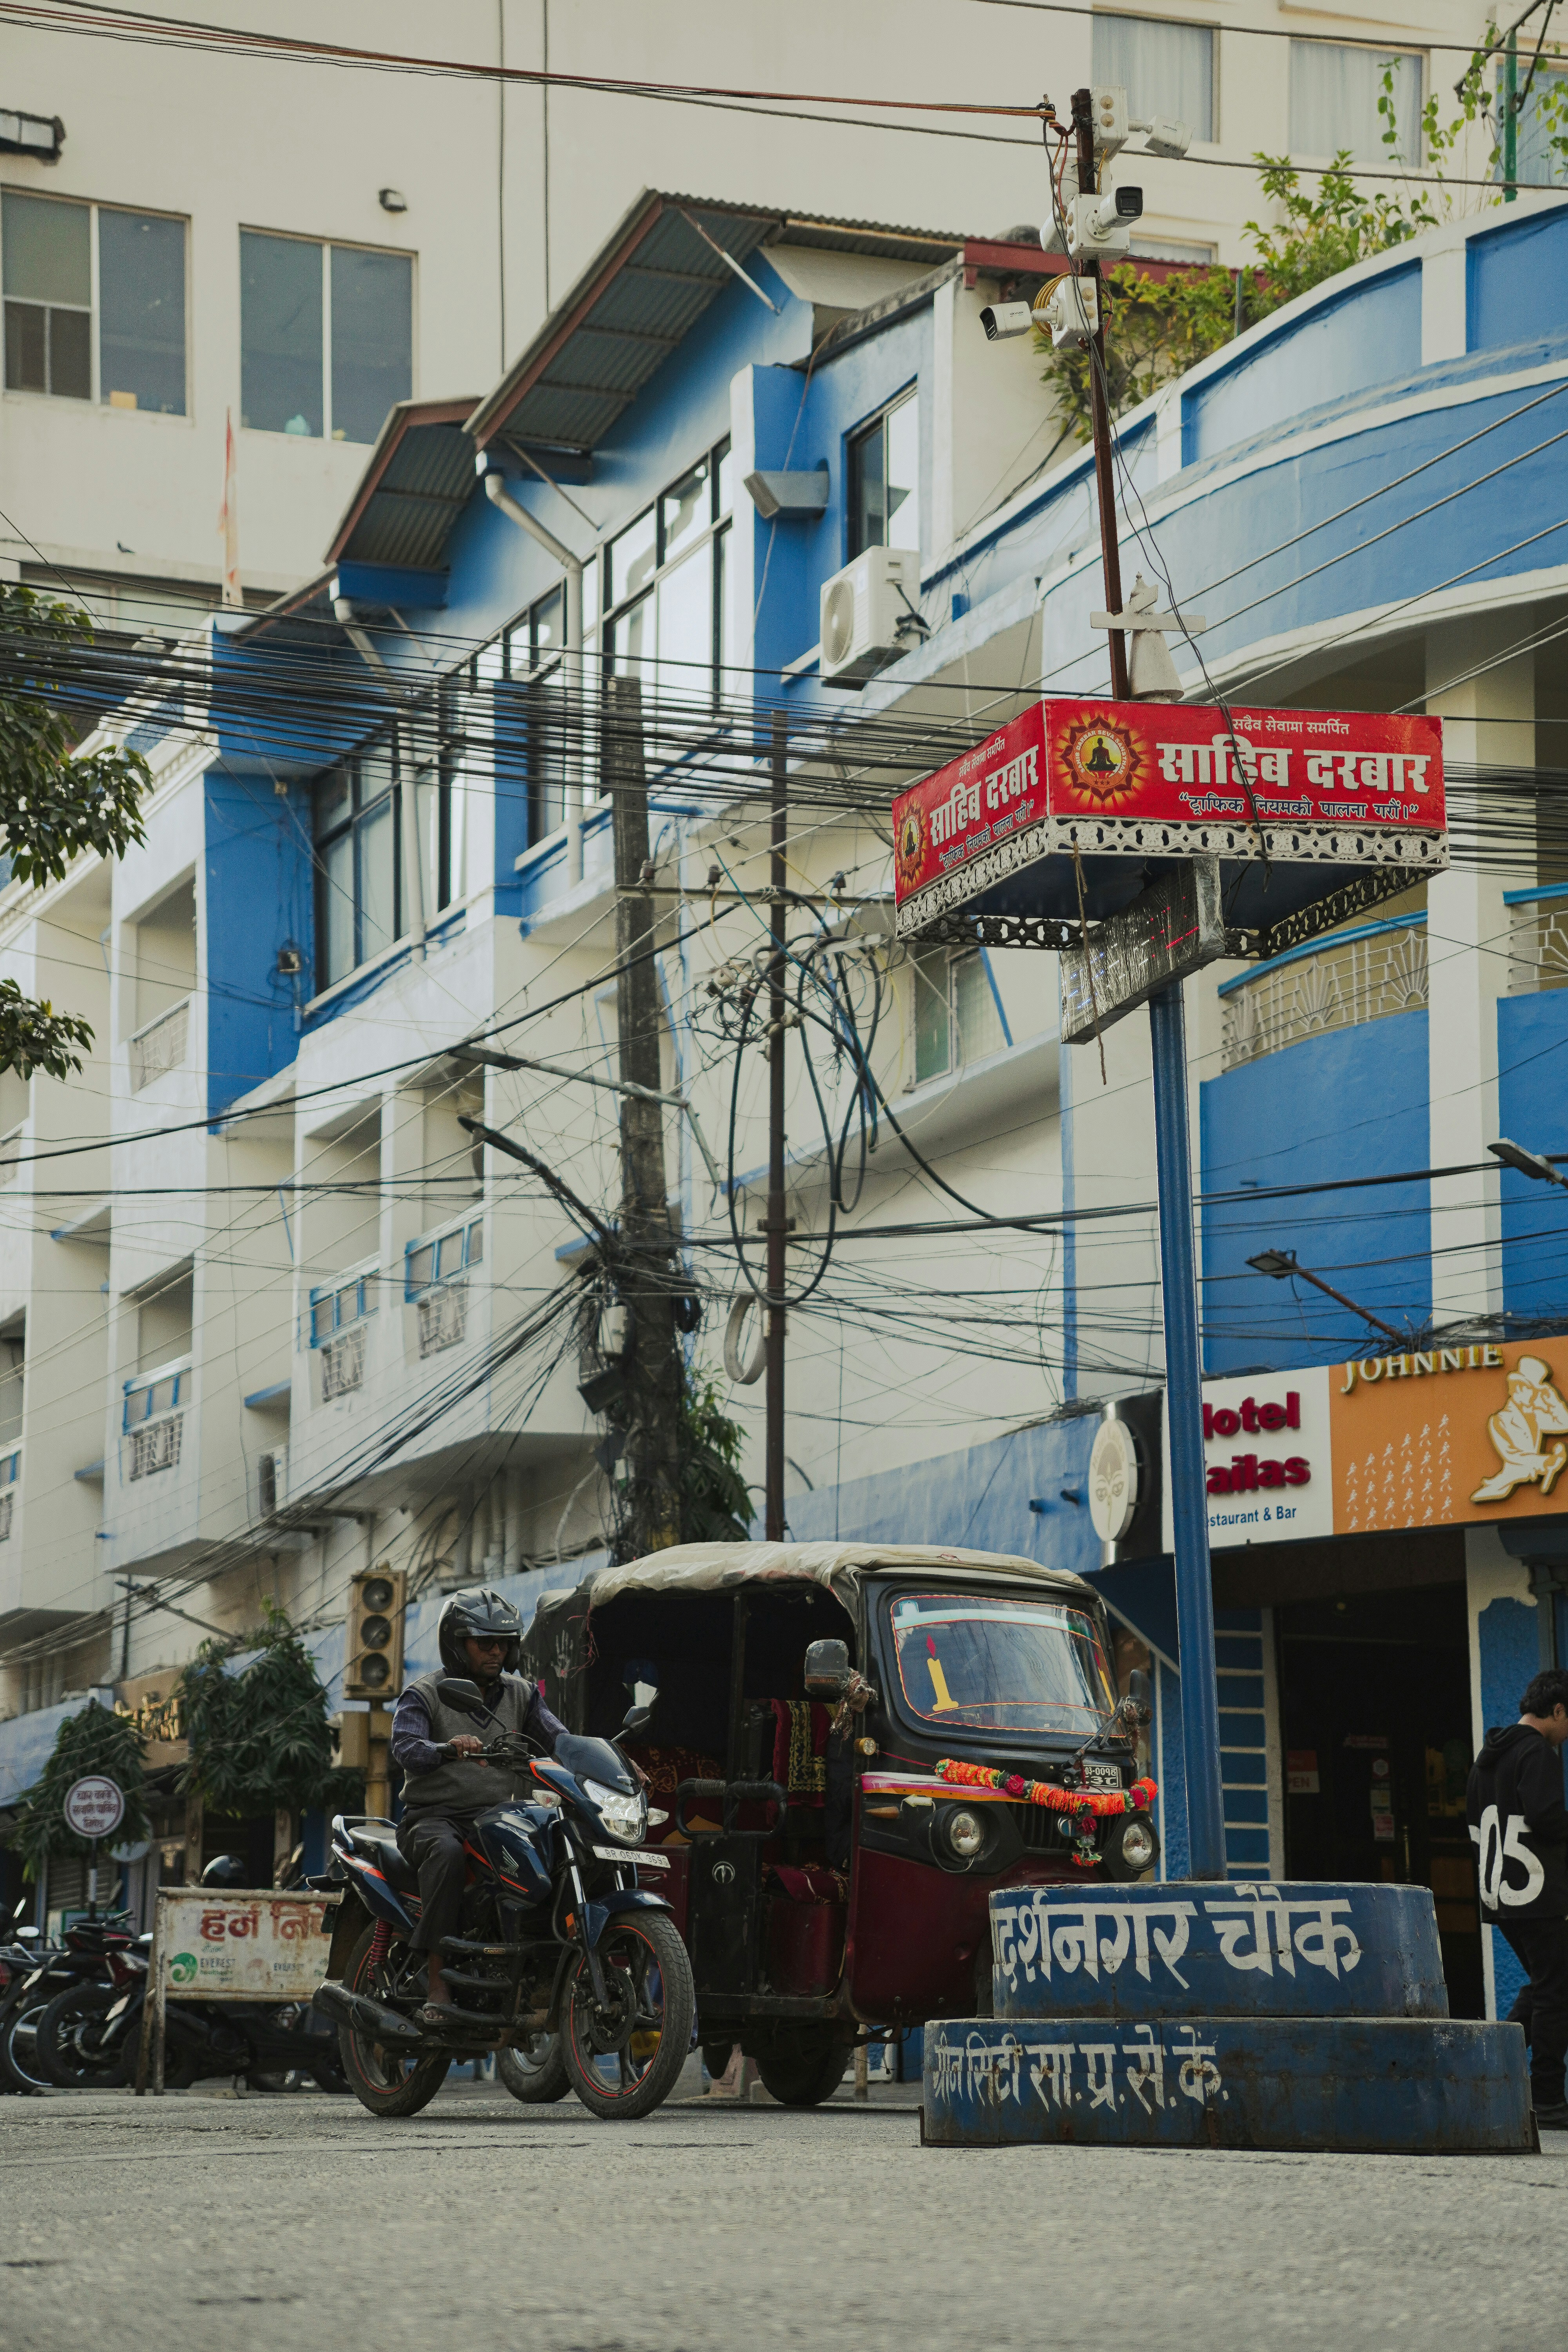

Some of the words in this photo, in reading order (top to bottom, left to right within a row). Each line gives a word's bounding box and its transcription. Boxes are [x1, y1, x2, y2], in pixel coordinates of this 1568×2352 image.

[1156, 733, 1293, 787] साहिब
[1304, 749, 1432, 793] दरबार
[929, 780, 982, 847] साहिब
[985, 744, 1039, 810] दरबार
[1318, 800, 1368, 818] पालना
[993, 813, 1014, 836] पालना
[1340, 1343, 1504, 1395] JOHNNIE
[1205, 1454, 1311, 1494] ailas
[1263, 1507, 1271, 1521] &
[1276, 1506, 1297, 1519] Bar
